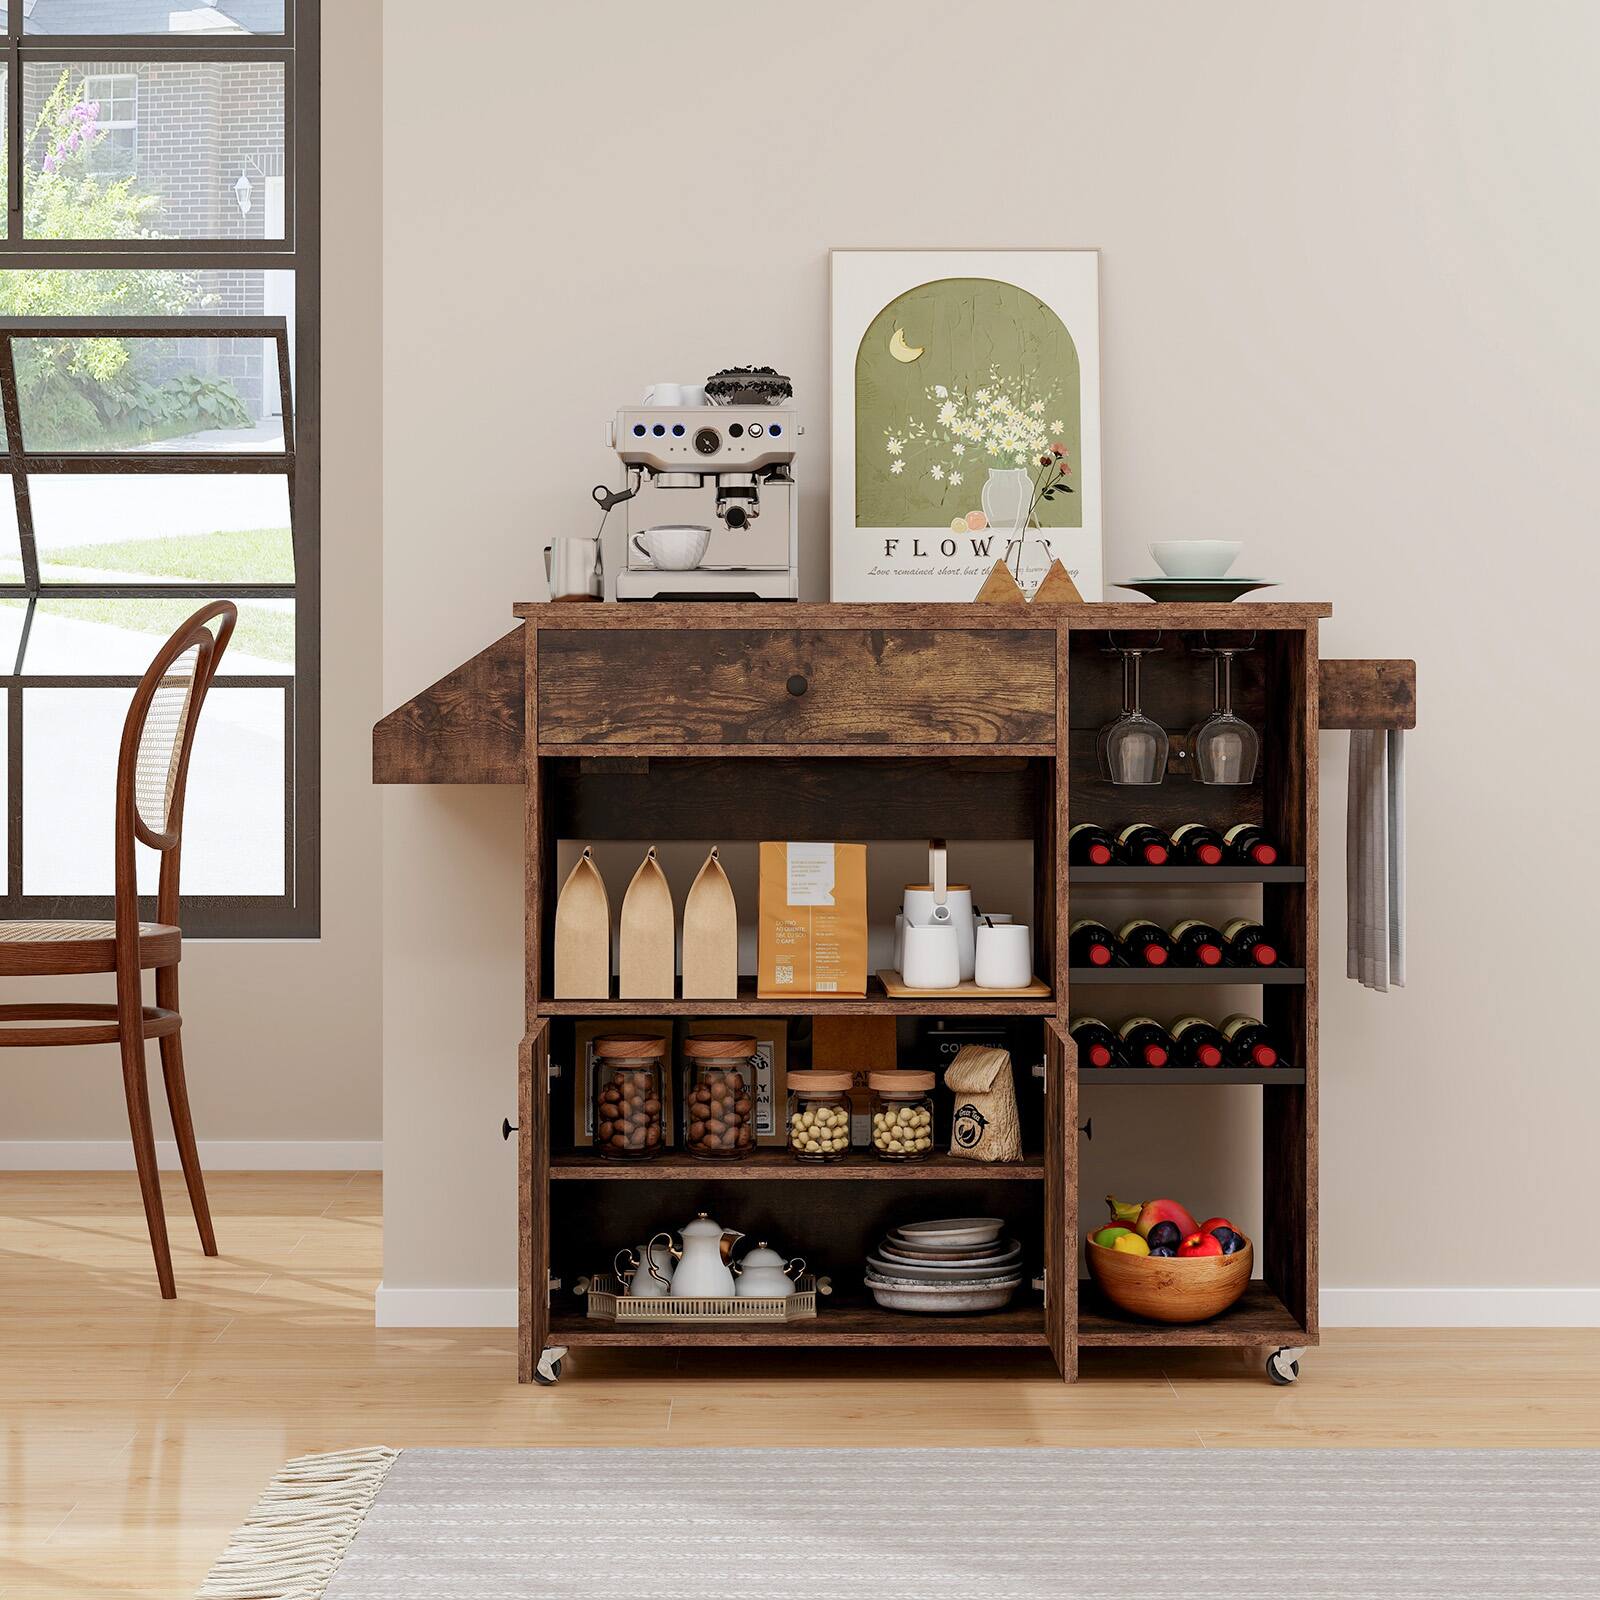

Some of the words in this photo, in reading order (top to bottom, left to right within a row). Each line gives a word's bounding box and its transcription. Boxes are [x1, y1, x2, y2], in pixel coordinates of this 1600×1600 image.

[884, 535, 1051, 557] FLOW
[867, 566, 890, 576] Love
[893, 566, 935, 576] remained
